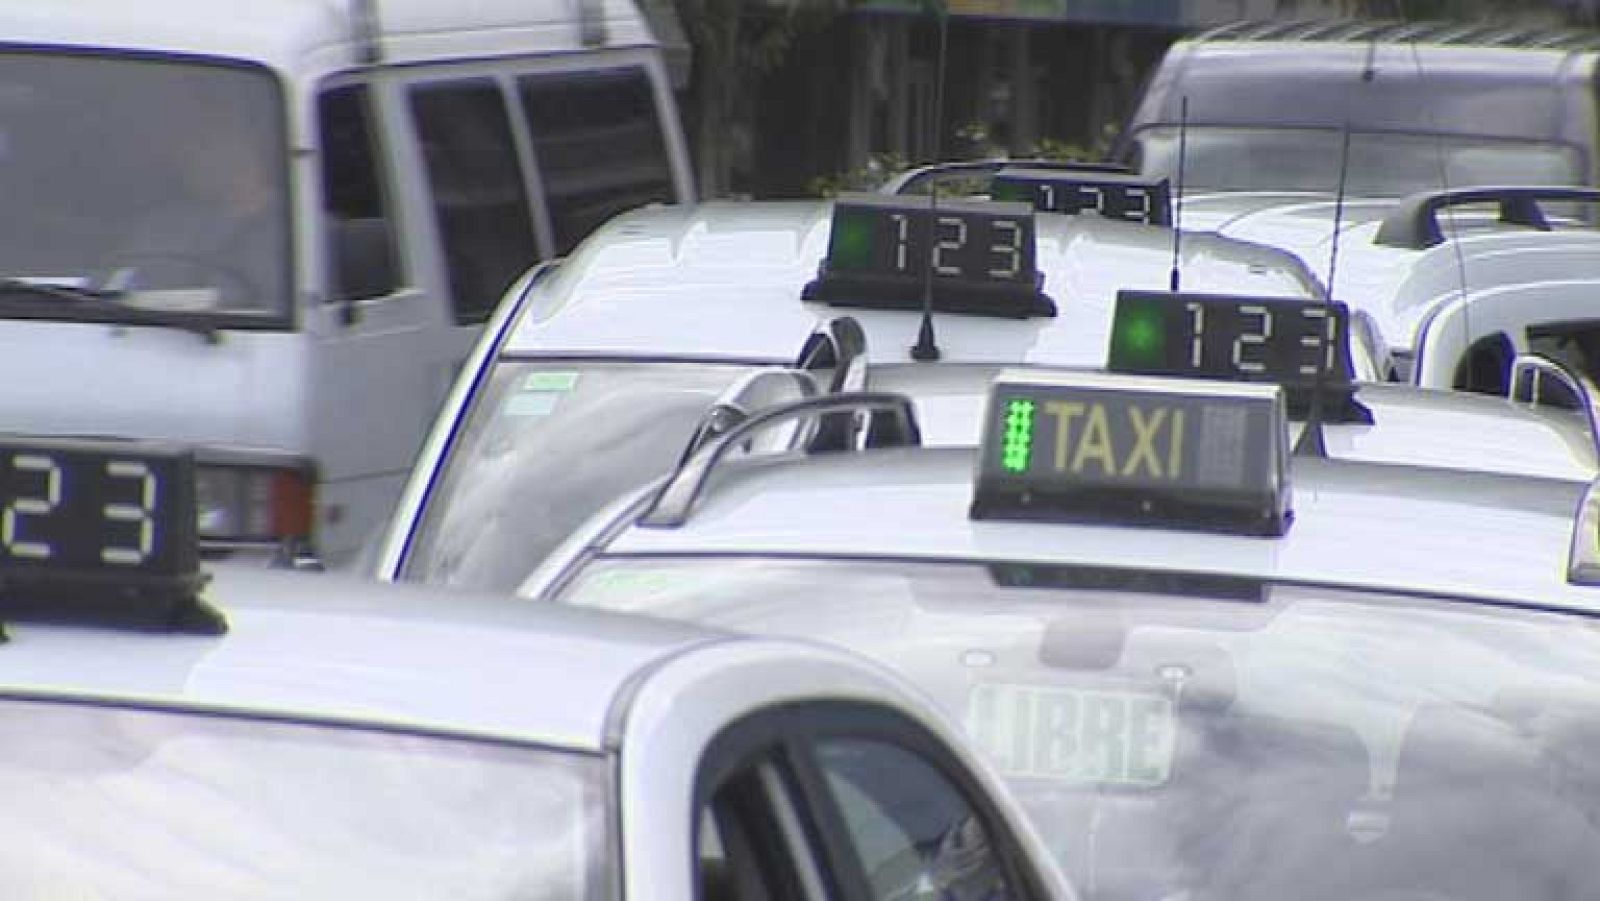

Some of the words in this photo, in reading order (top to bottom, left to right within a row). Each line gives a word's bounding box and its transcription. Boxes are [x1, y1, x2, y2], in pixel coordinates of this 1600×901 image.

[889, 213, 1022, 277] 123
[1186, 301, 1336, 374] 123
[1042, 399, 1187, 479] TAXI
